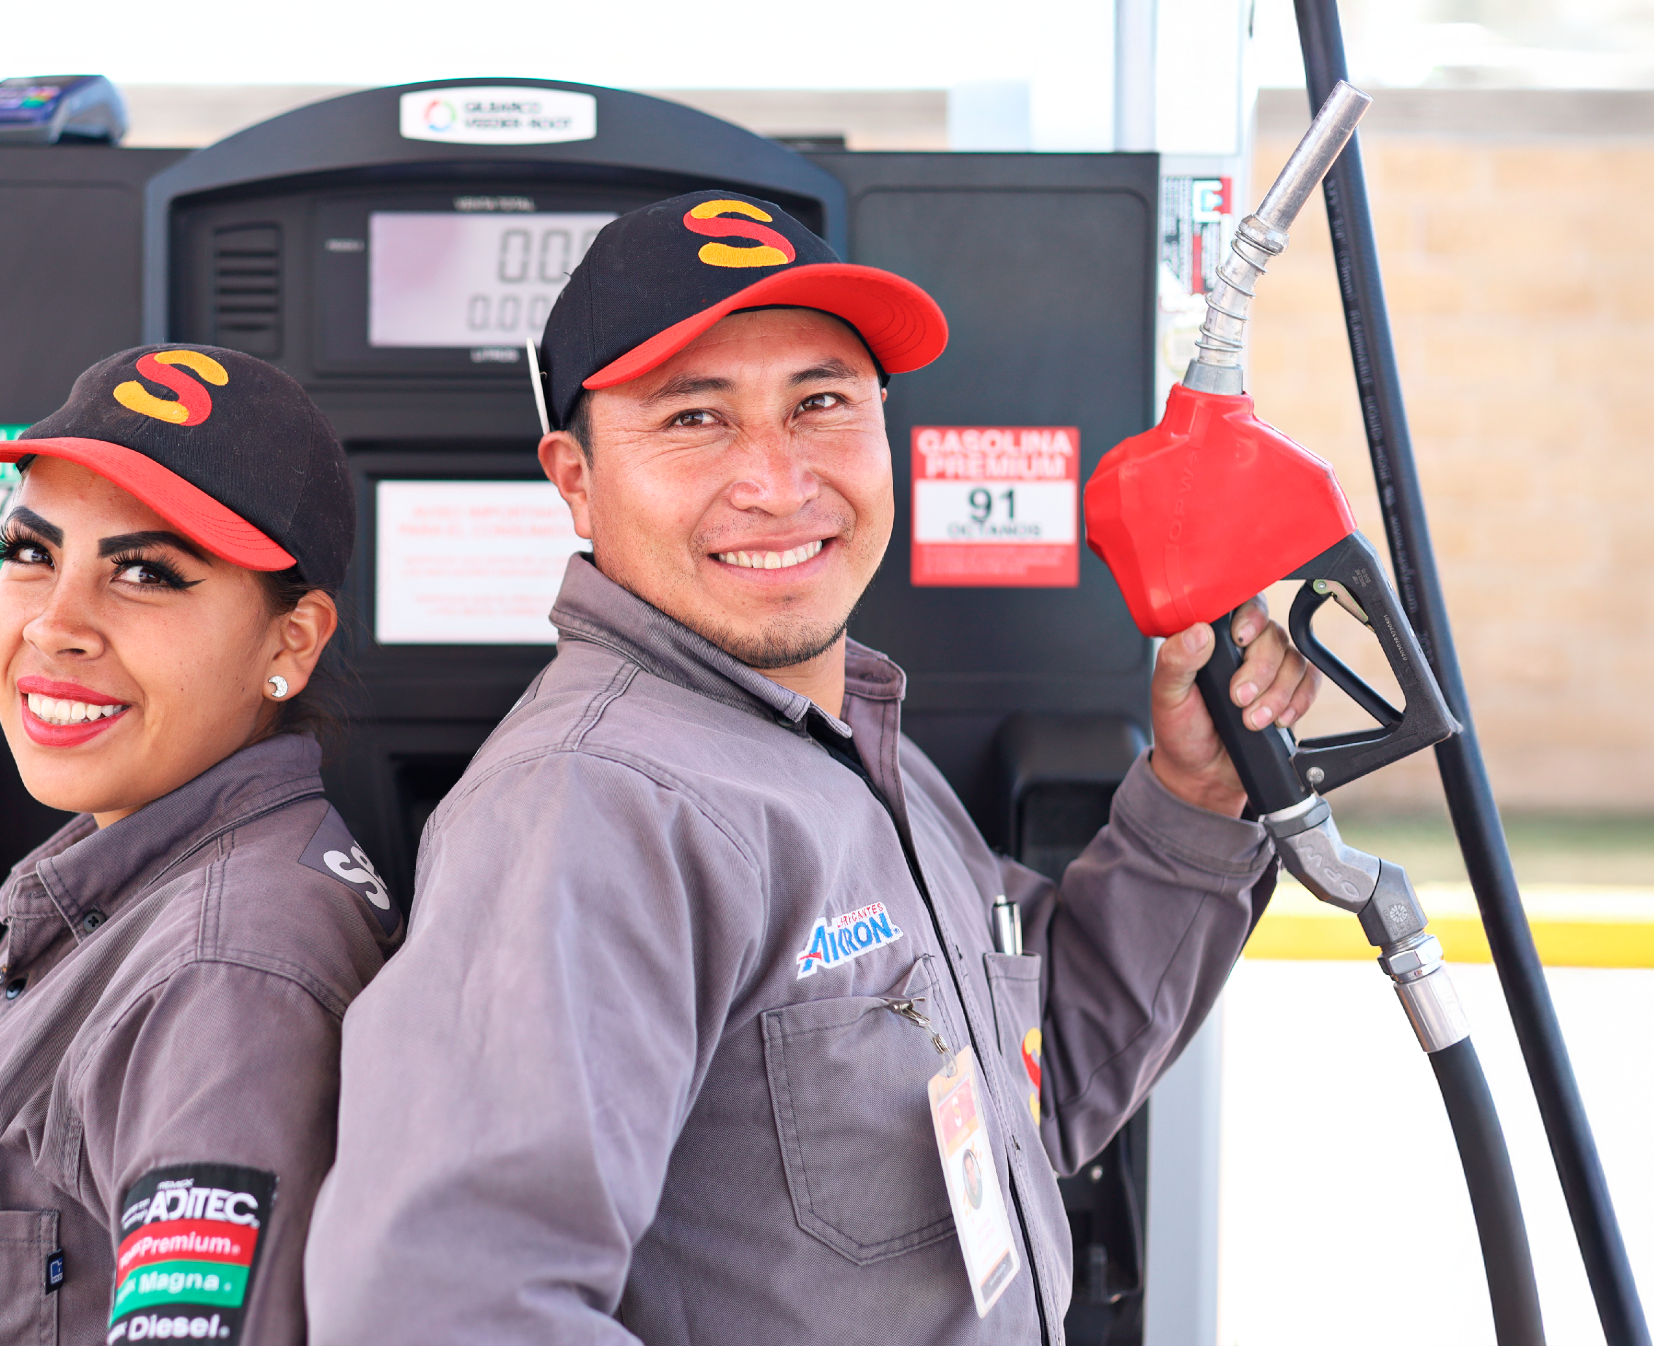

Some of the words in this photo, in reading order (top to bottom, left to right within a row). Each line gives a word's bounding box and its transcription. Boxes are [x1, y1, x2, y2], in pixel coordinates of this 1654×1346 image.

[917, 429, 1074, 456] GASOLINA
[926, 455, 1066, 479] PREMIUM
[969, 487, 1015, 522] 91
